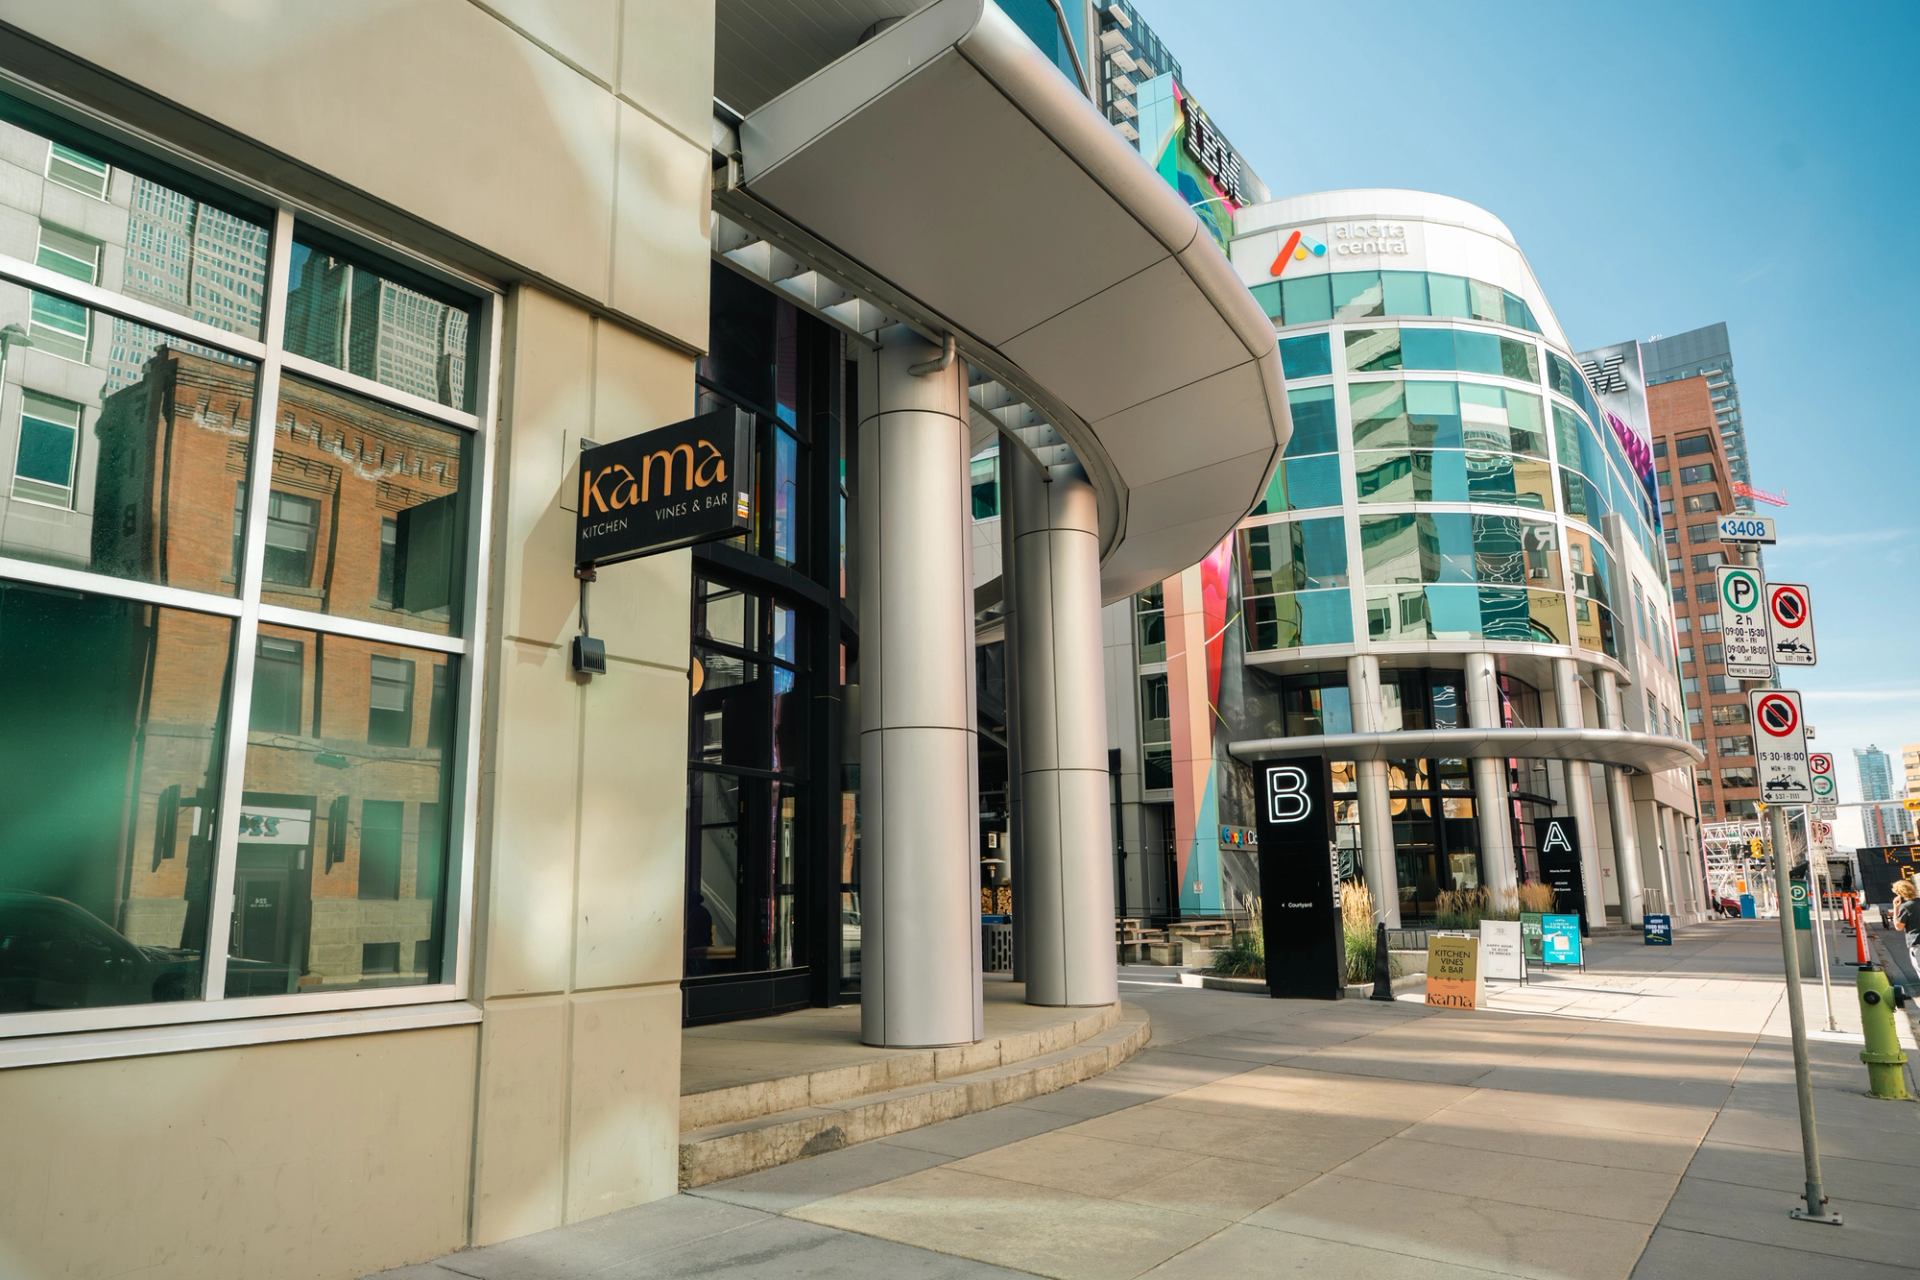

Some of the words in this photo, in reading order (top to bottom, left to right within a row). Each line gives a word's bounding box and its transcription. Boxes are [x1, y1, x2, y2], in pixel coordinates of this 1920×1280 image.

[1181, 98, 1244, 208] IBM
[1334, 223, 1406, 240] alberta
[1337, 238, 1408, 256] central
[582, 518, 628, 540] KITCHEN
[655, 504, 687, 521] VINES
[692, 499, 701, 513] &
[706, 492, 728, 509] BAR
[1728, 520, 1766, 537] 3408
[1733, 580, 1750, 604] P
[1735, 615, 1743, 625] 2
[1746, 615, 1753, 626] h
[1266, 766, 1311, 823] B
[1222, 826, 1248, 848] Googe
[1543, 821, 1572, 852] A
[1328, 840, 1341, 908] DISTRICT
[1434, 949, 1471, 959] KITCHEN
[1441, 957, 1464, 967] VINES
[1448, 966, 1464, 974] BAR
